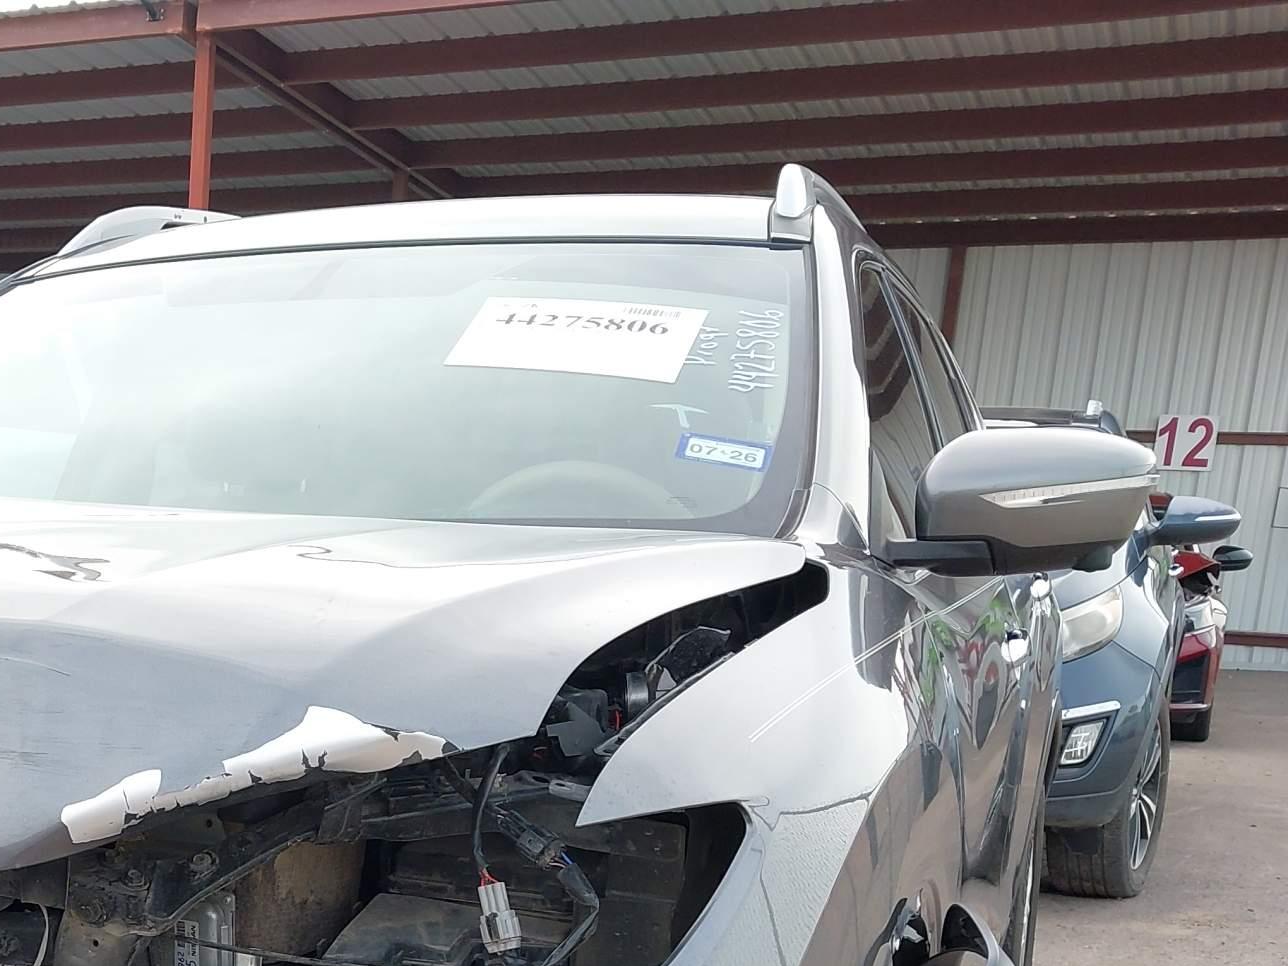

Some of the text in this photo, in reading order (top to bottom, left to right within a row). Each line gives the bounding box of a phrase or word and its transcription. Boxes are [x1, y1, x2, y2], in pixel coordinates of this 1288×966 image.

[495, 312, 670, 335] 44275806
[727, 308, 785, 393] 44275806
[1158, 417, 1214, 467] 12
